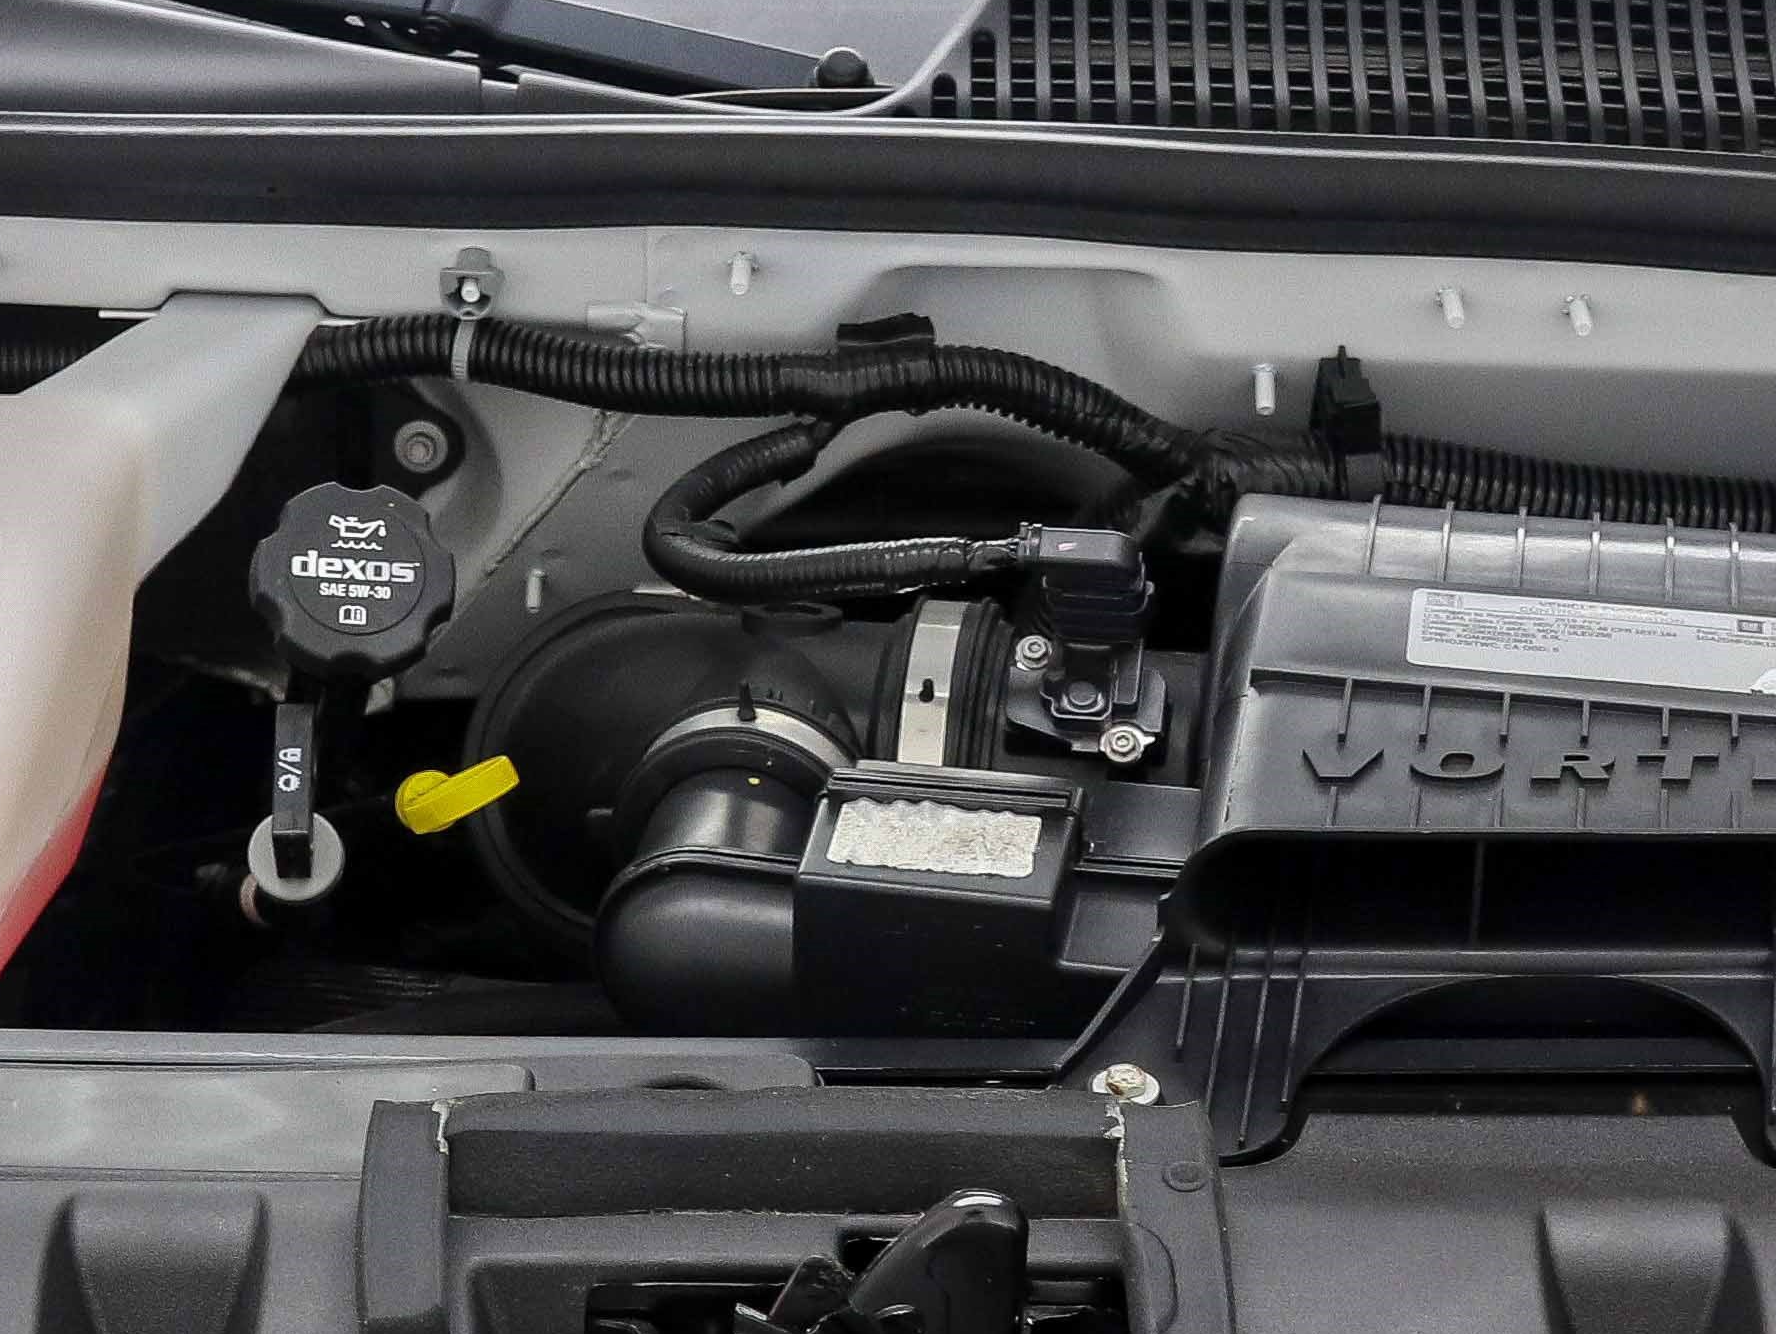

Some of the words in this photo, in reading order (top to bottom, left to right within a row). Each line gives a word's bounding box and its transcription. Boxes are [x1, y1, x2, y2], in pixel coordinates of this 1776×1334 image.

[290, 549, 420, 583] dexos
[319, 583, 346, 597] SAE
[348, 584, 392, 599] 5W-30
